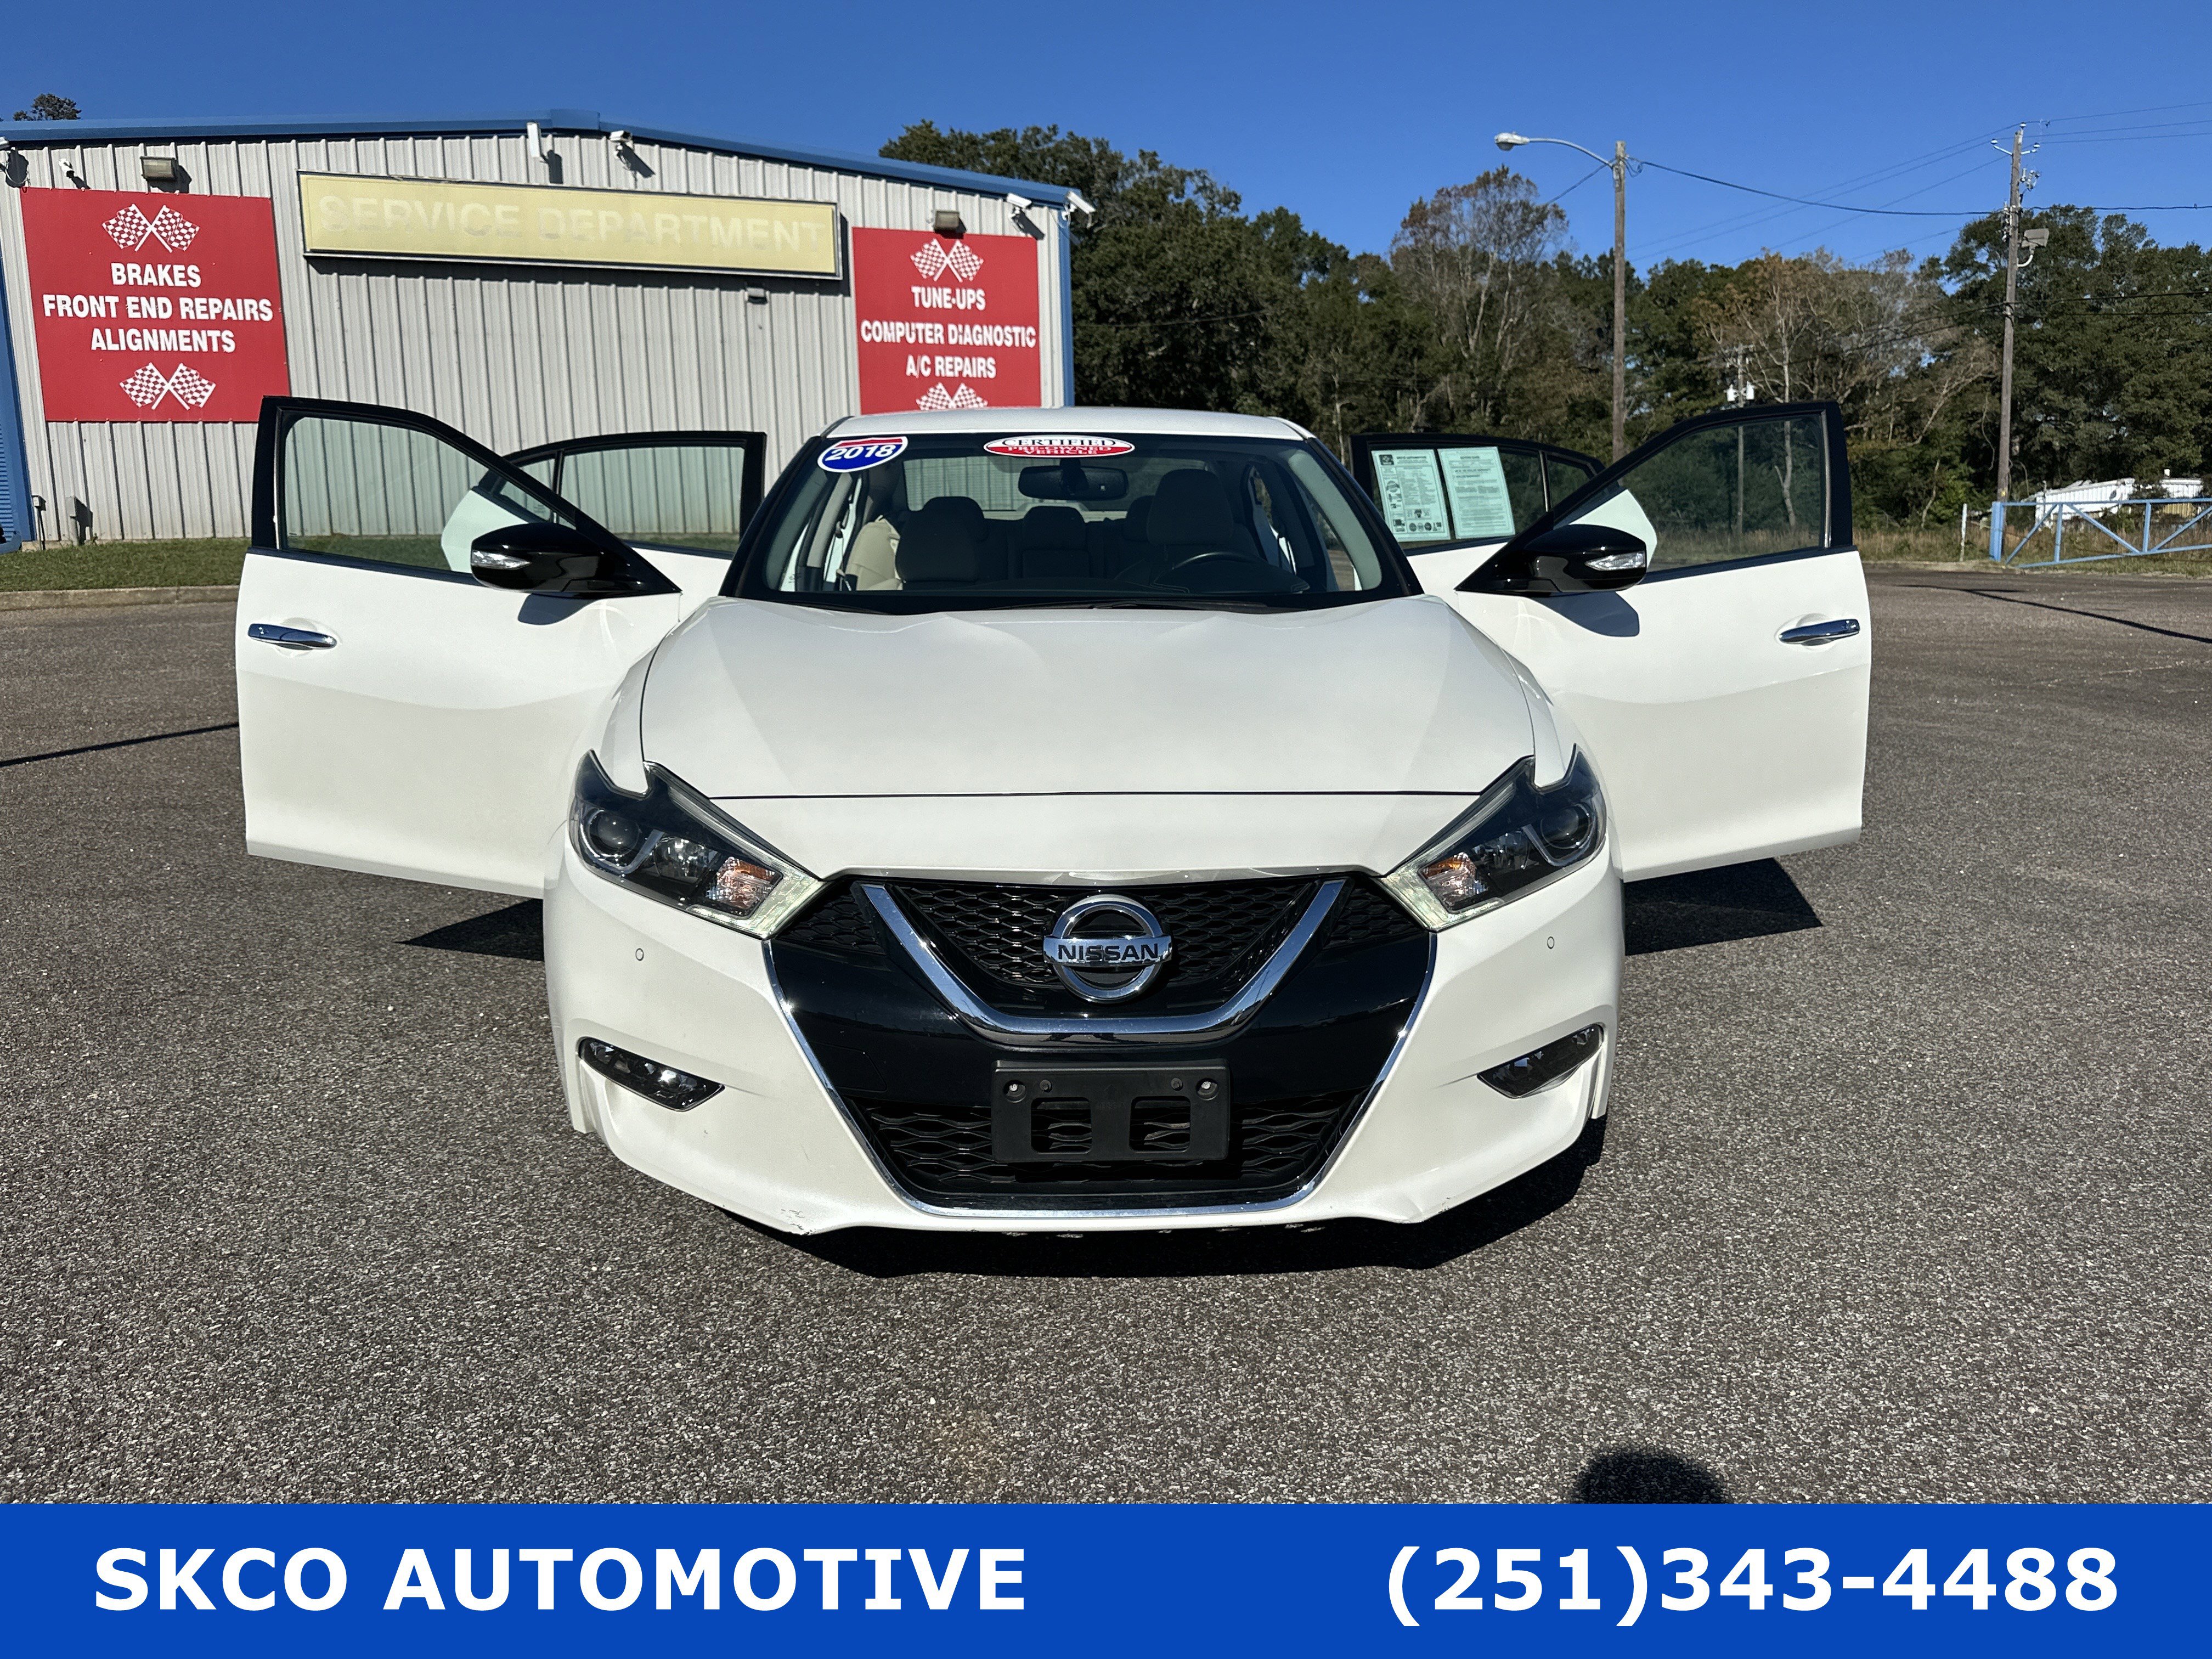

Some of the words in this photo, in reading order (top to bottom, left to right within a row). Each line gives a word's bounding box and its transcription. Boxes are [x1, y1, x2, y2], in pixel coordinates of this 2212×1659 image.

[319, 195, 522, 239] SERVICE
[538, 207, 827, 253] DEPARTMENT
[111, 262, 201, 288] BRAKES
[42, 294, 120, 318] FRONT
[126, 296, 173, 319] END
[179, 297, 273, 322] REPAIRS
[911, 285, 986, 311] TUNE-UPS
[91, 328, 236, 353] ALIGNMENTS
[860, 319, 945, 345] COMPUTER
[947, 323, 1036, 348] DIAGNOSTIC
[906, 354, 932, 379] A/C
[934, 355, 997, 379] REPAIRS
[825, 444, 896, 461] 2018
[1057, 943, 1159, 961] NISSAN
